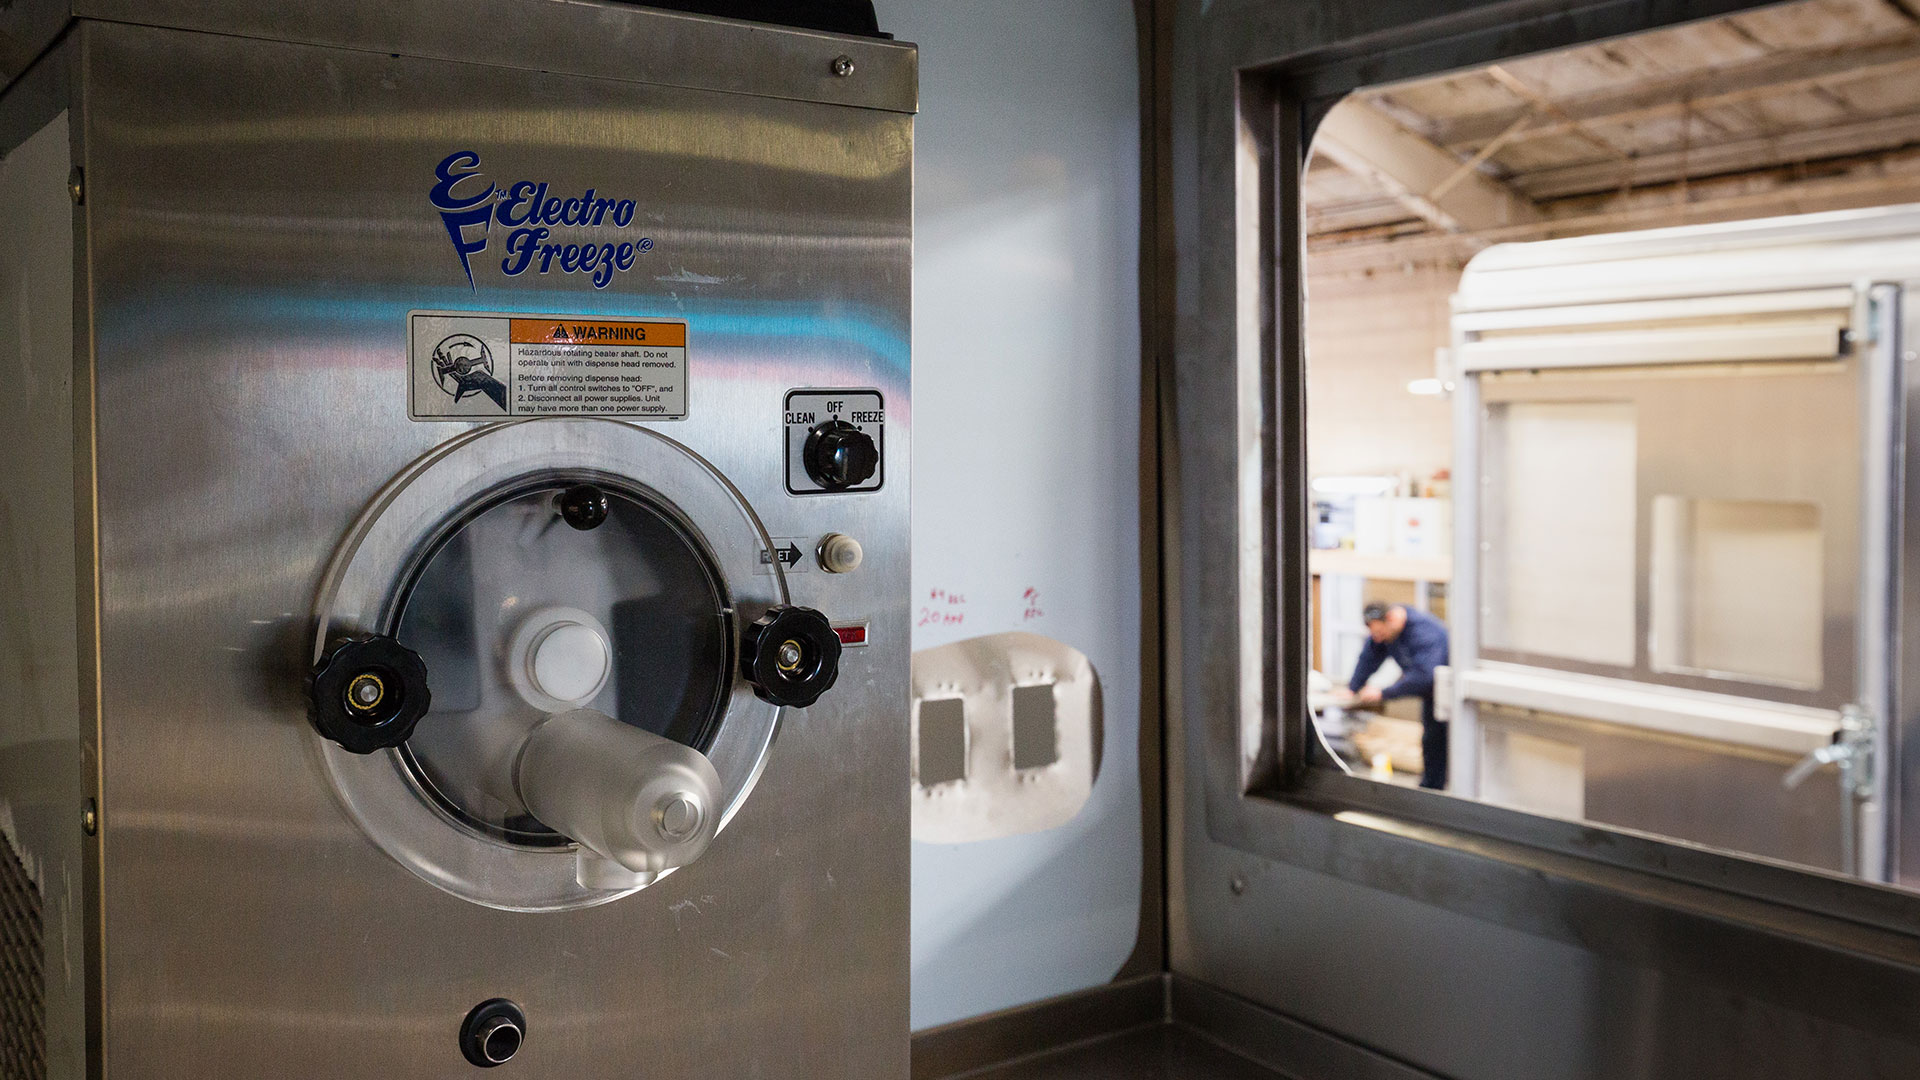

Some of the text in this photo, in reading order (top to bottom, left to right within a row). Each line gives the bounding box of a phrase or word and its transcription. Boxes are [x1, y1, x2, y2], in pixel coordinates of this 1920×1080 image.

[496, 181, 637, 228] Electro
[573, 326, 646, 341] WARNING
[518, 348, 669, 359] Hazardous rotating beater shaft. Do not
[518, 360, 677, 369] operate unit with dispense head removed.
[518, 374, 643, 384] Before removing dispense head:
[518, 384, 526, 392] 1.
[528, 384, 547, 392] Turn
[548, 384, 558, 392] all
[587, 385, 621, 393] switches
[622, 385, 631, 393] to
[659, 385, 674, 393] and
[518, 394, 661, 404] 2. Disconnect all power supplies. Unit
[518, 406, 536, 414] may
[616, 406, 640, 414] power
[641, 405, 668, 414] supply.
[827, 401, 844, 413] OFF
[785, 412, 815, 424] CLEAN
[851, 411, 884, 423] FREEZE
[918, 607, 941, 627] 20
